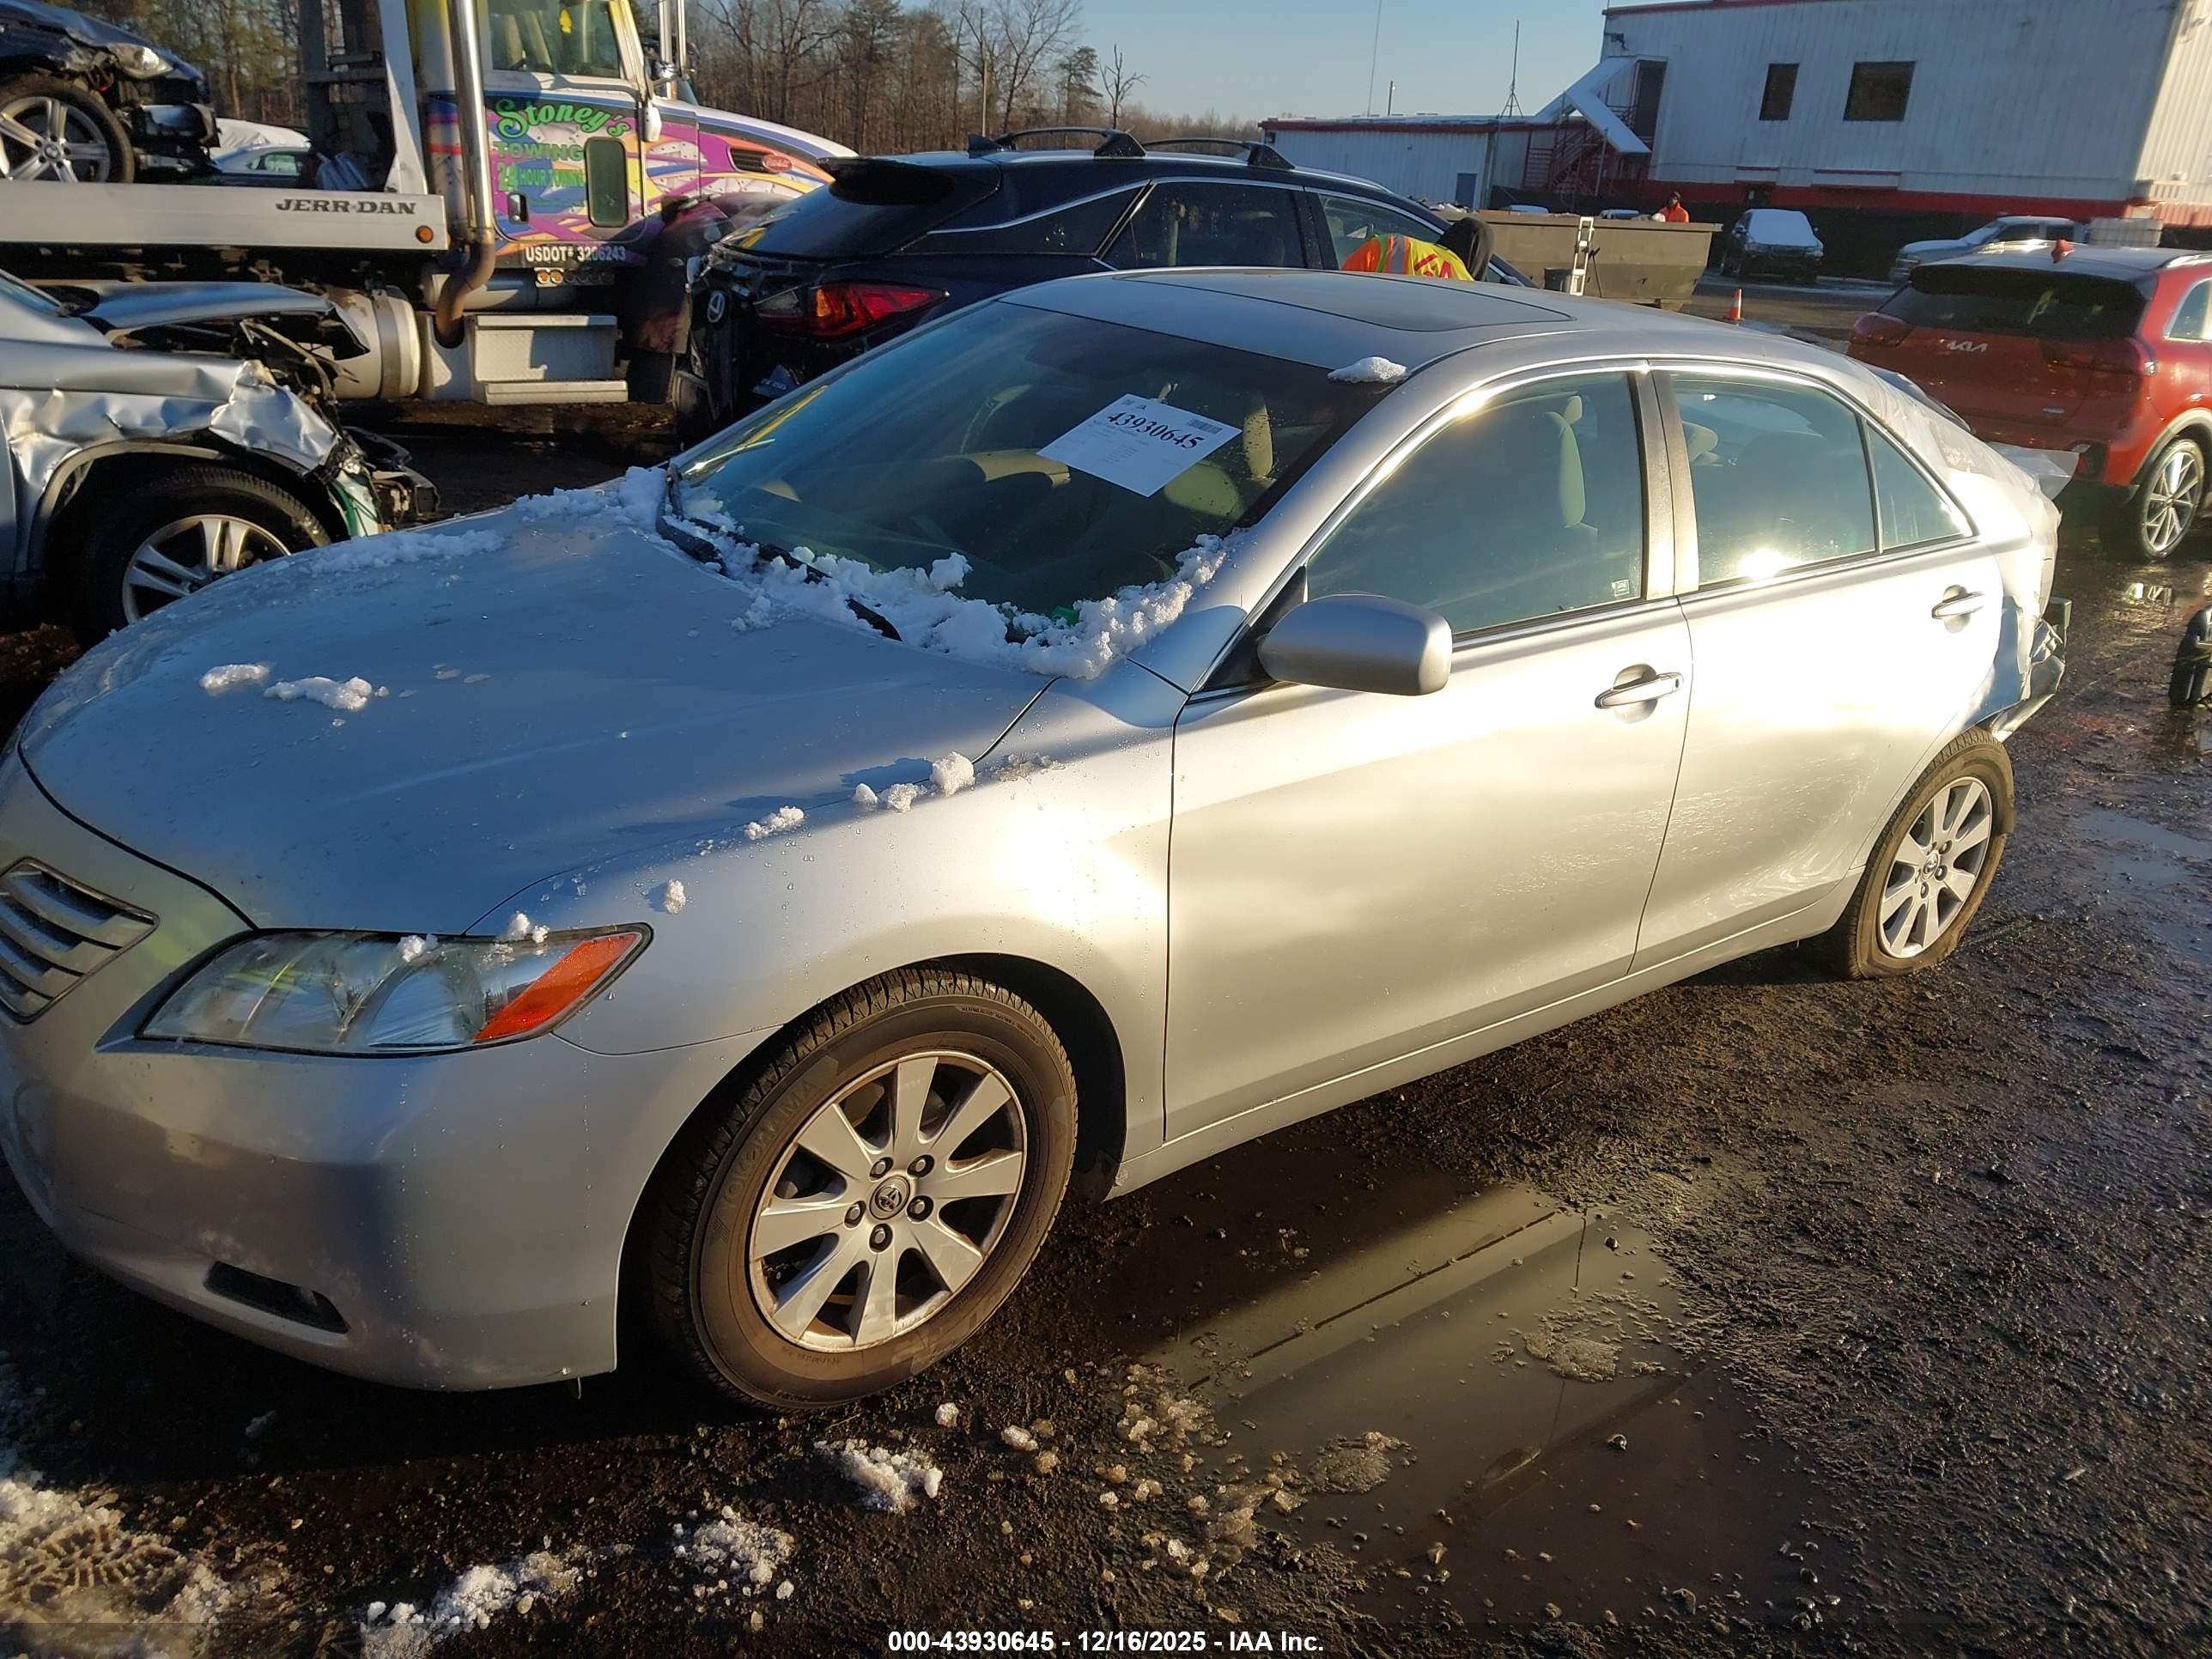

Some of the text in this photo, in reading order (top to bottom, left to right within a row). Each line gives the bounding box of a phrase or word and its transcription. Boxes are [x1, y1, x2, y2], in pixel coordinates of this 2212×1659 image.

[495, 98, 631, 138] Stoney's
[493, 140, 584, 161] TOWING
[497, 161, 518, 191] 24
[520, 168, 547, 185] HOUR
[577, 246, 626, 262] 3206243
[1107, 411, 1205, 450] 43930645
